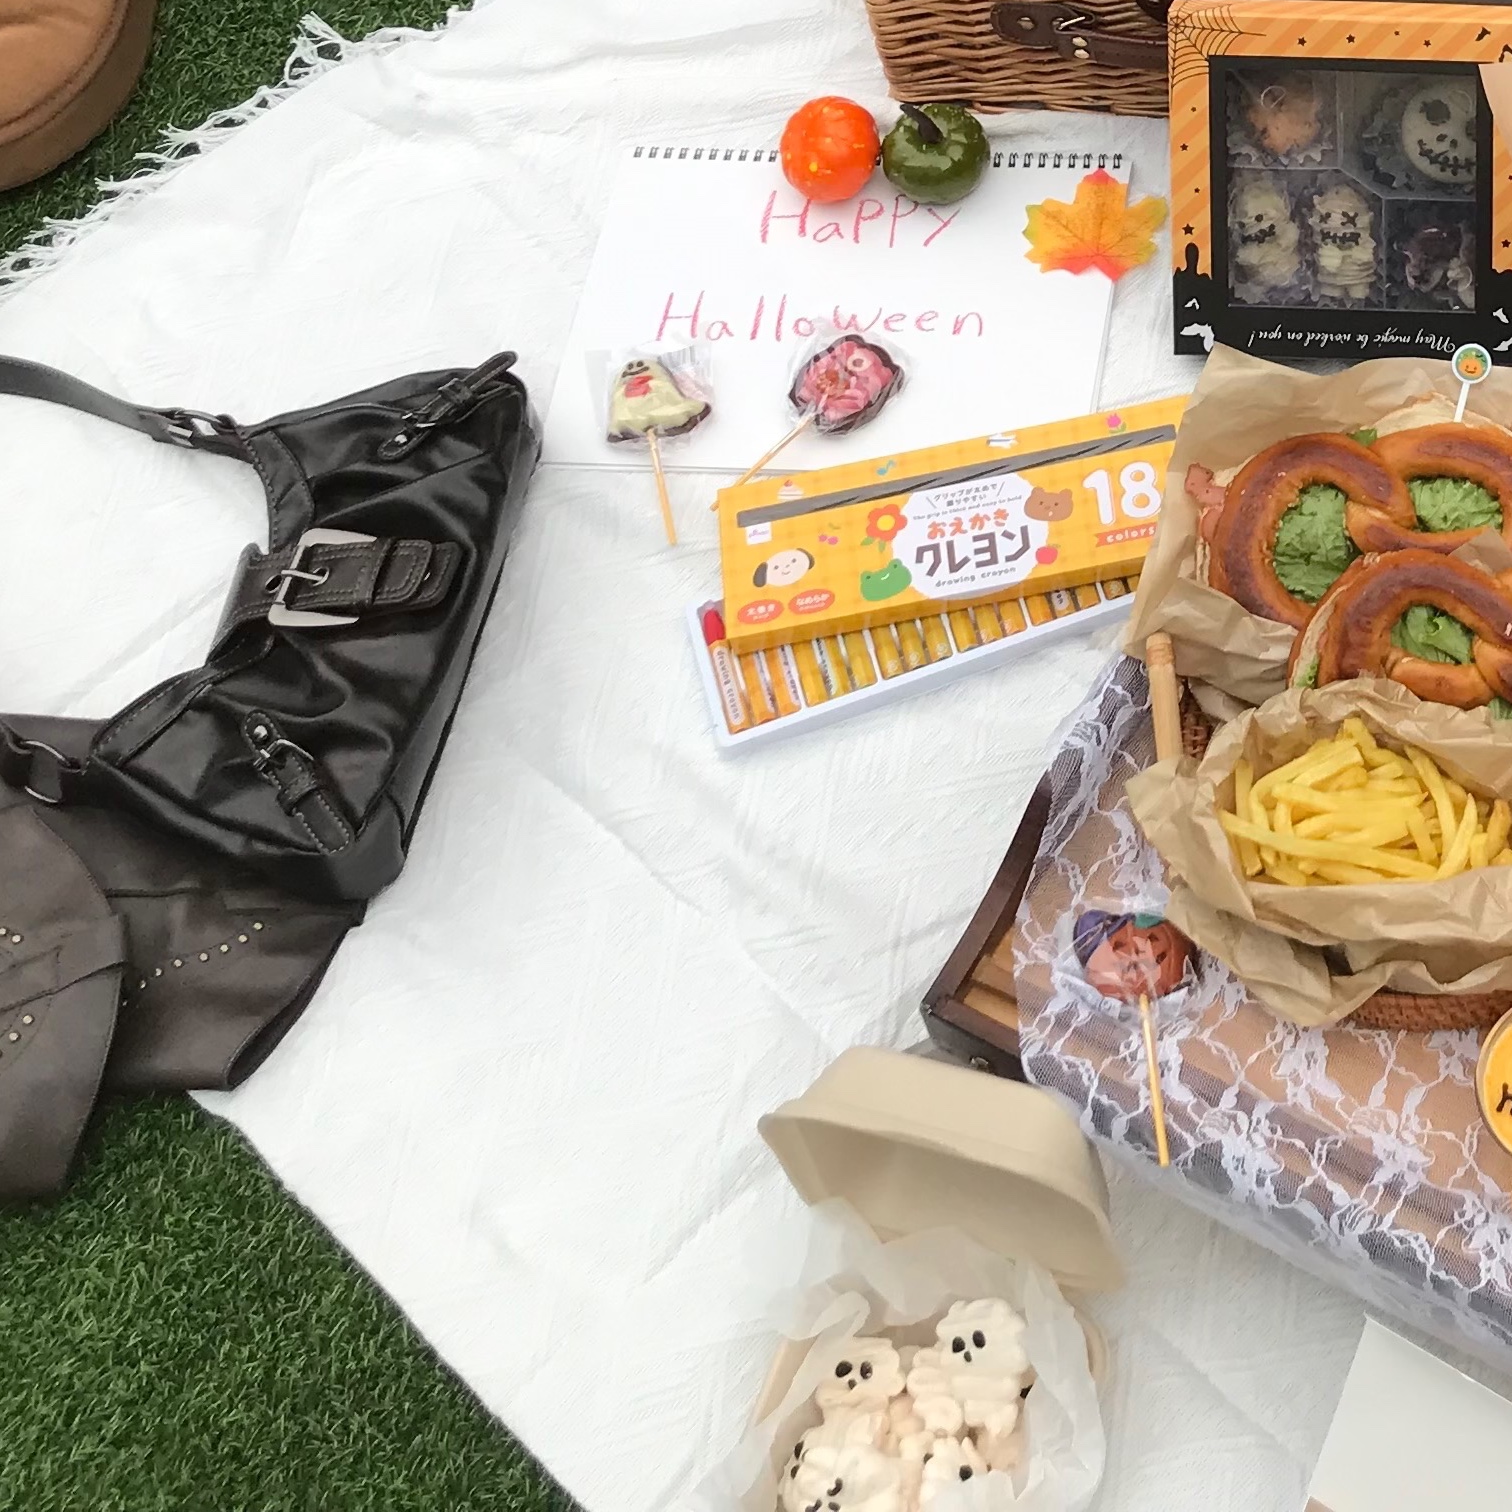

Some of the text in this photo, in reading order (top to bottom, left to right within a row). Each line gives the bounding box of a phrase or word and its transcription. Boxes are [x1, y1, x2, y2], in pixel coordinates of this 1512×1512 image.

[655, 290, 984, 342] Halloween
[1286, 331, 1303, 340] on
[1303, 331, 1352, 348] worked
[1356, 332, 1370, 349] be
[1373, 326, 1411, 348] magic
[1414, 328, 1456, 353] May
[1082, 461, 1162, 526] 18
[927, 508, 1010, 540] おえかき
[1106, 526, 1155, 544] colors
[915, 524, 1031, 577] クレヨン
[935, 567, 1016, 588] drawing crayon
[716, 649, 740, 720] drawing crayon
